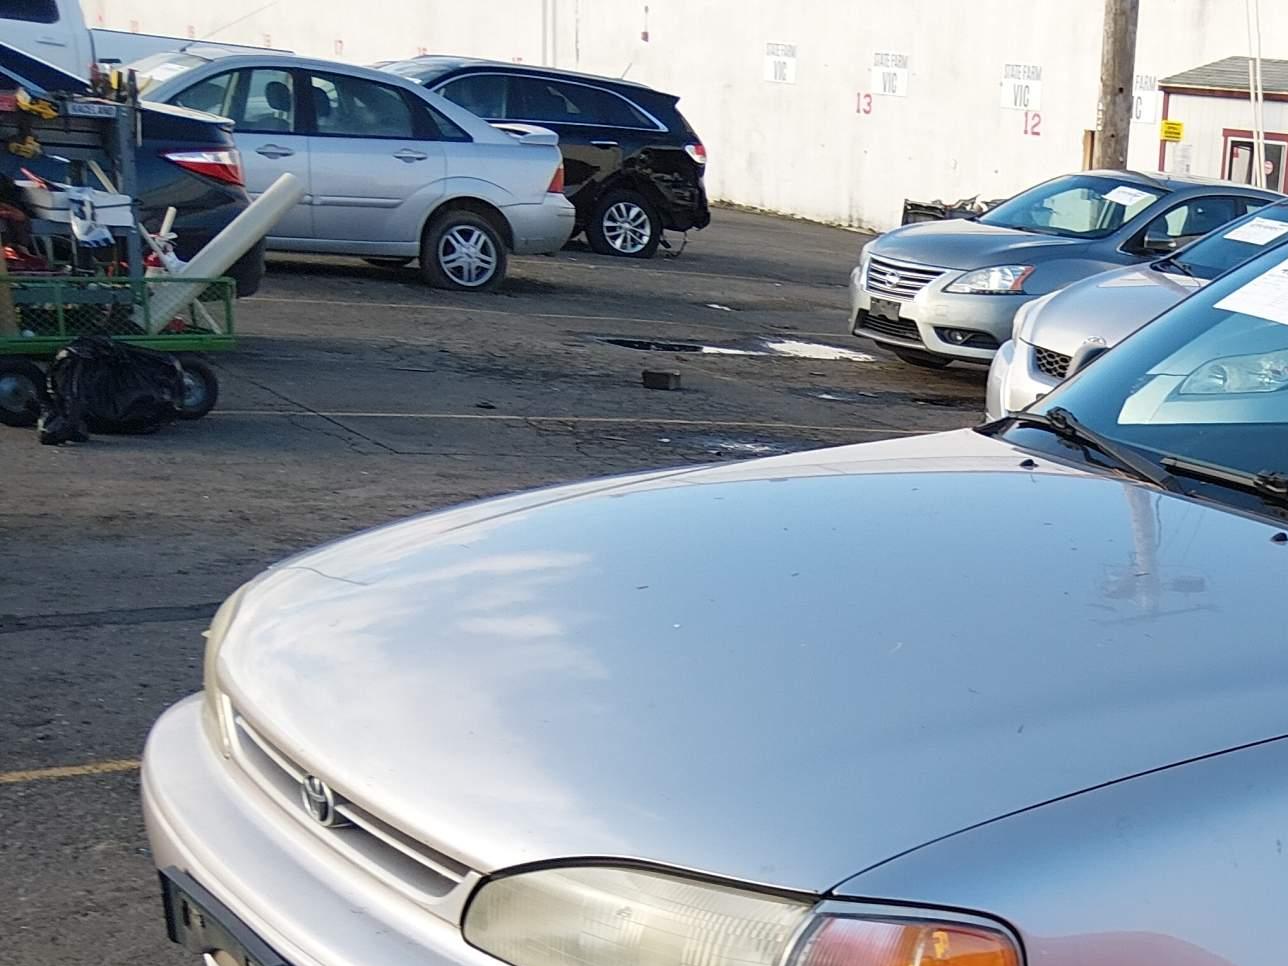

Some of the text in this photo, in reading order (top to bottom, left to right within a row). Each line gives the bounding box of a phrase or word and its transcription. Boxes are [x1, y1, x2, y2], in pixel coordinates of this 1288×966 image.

[882, 72, 897, 93] VIC
[1004, 63, 1042, 81] STATE FARM
[1135, 75, 1157, 91] FARM
[856, 92, 872, 114] 13
[1012, 83, 1030, 108] VIC
[1023, 112, 1041, 136] 12
